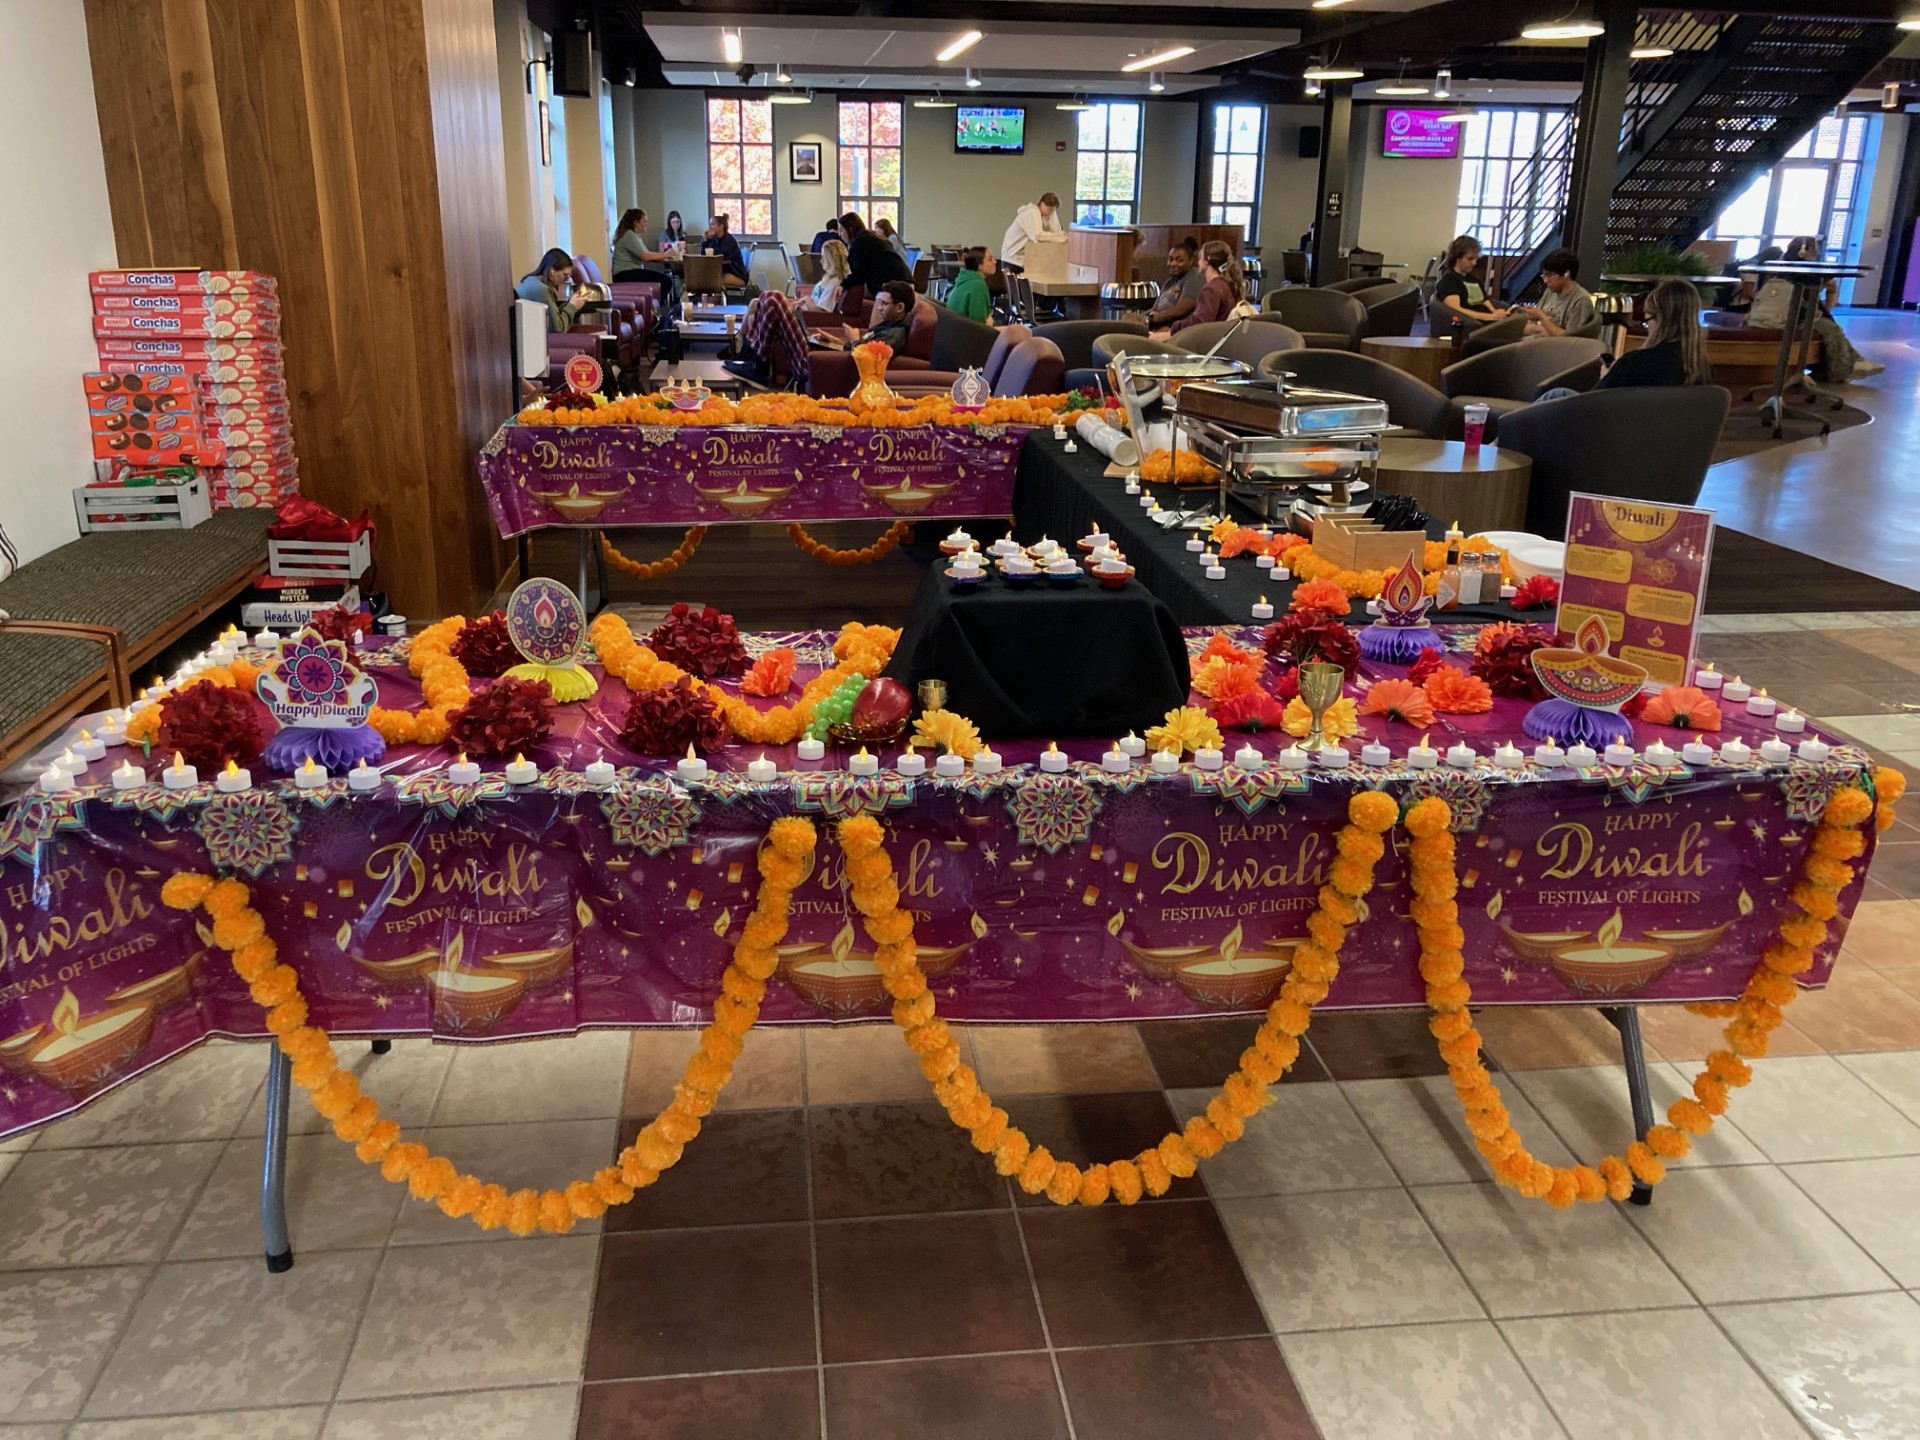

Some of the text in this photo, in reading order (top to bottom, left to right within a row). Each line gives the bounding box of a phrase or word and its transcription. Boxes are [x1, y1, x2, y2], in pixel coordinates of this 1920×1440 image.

[127, 274, 175, 285] Conchas
[132, 297, 179, 307] Conchas
[133, 317, 180, 328] Conchas
[135, 340, 181, 351] Conchas
[137, 362, 184, 373] Conchas
[560, 436, 594, 447] HAPPY
[731, 433, 763, 443] HAPPY
[869, 433, 946, 462] Diwali
[532, 441, 614, 469] Diwali
[703, 436, 783, 466] Diwali
[753, 468, 779, 476] LIGHTS
[1614, 506, 1665, 527] Diwali
[280, 594, 310, 602] MYSTERY
[264, 609, 311, 624] Heads Up!
[275, 703, 365, 718] Happy Diwali
[1604, 812, 1680, 832] HAPPY
[1219, 823, 1295, 843] HAPPY
[1536, 821, 1713, 880] Diwali
[1151, 832, 1331, 895] Diwali
[6, 860, 88, 908] HPPY
[365, 842, 549, 907] Diwali
[1538, 890, 1702, 905] FESTIVAL OF LIGHTS
[0, 867, 154, 969] iwali
[1161, 896, 1316, 922] FESTIVAL OF LIGHTS
[384, 906, 458, 934] FESTIVAL
[460, 906, 476, 923] OF
[58, 960, 84, 981] OF
[89, 932, 157, 970] LIGHTS
